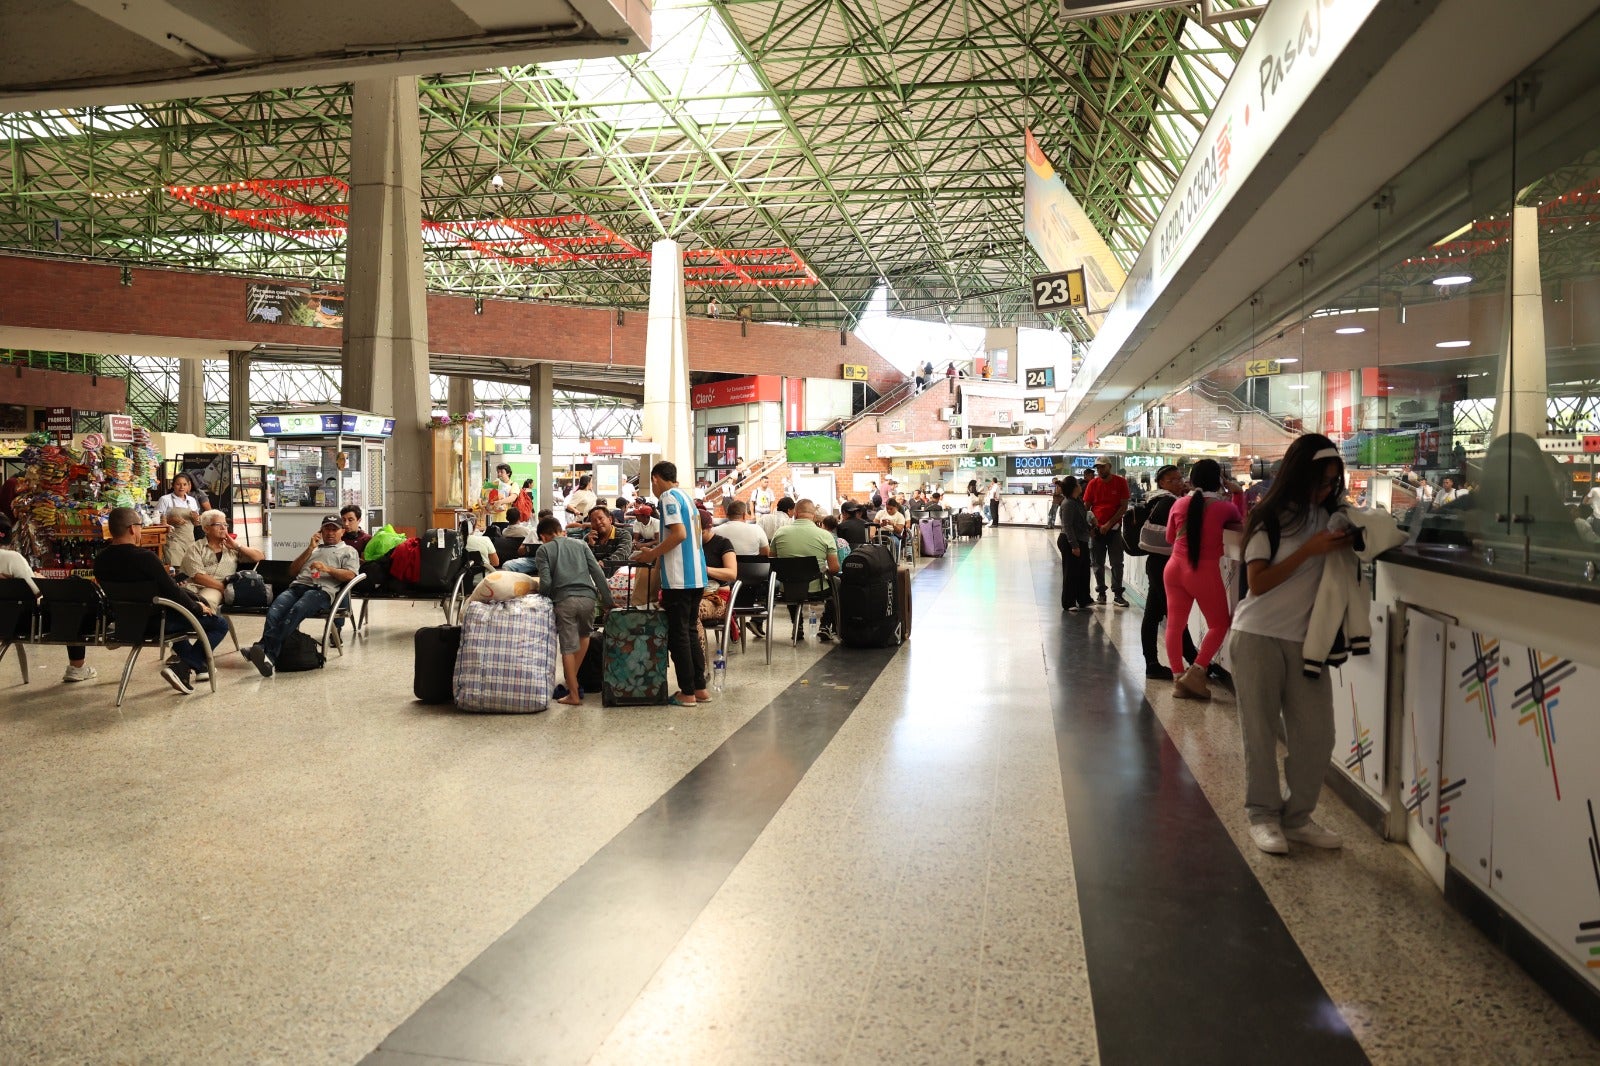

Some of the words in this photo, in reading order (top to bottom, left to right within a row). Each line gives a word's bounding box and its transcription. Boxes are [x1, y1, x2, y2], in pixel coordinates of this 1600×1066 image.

[1259, 0, 1334, 112] Pasaj
[1186, 144, 1218, 223] OCHOA
[1036, 279, 1069, 306] 23
[1028, 371, 1046, 386] 24
[695, 390, 713, 404] Claro
[1025, 399, 1039, 411] 25
[1015, 457, 1053, 468] BOGOTA
